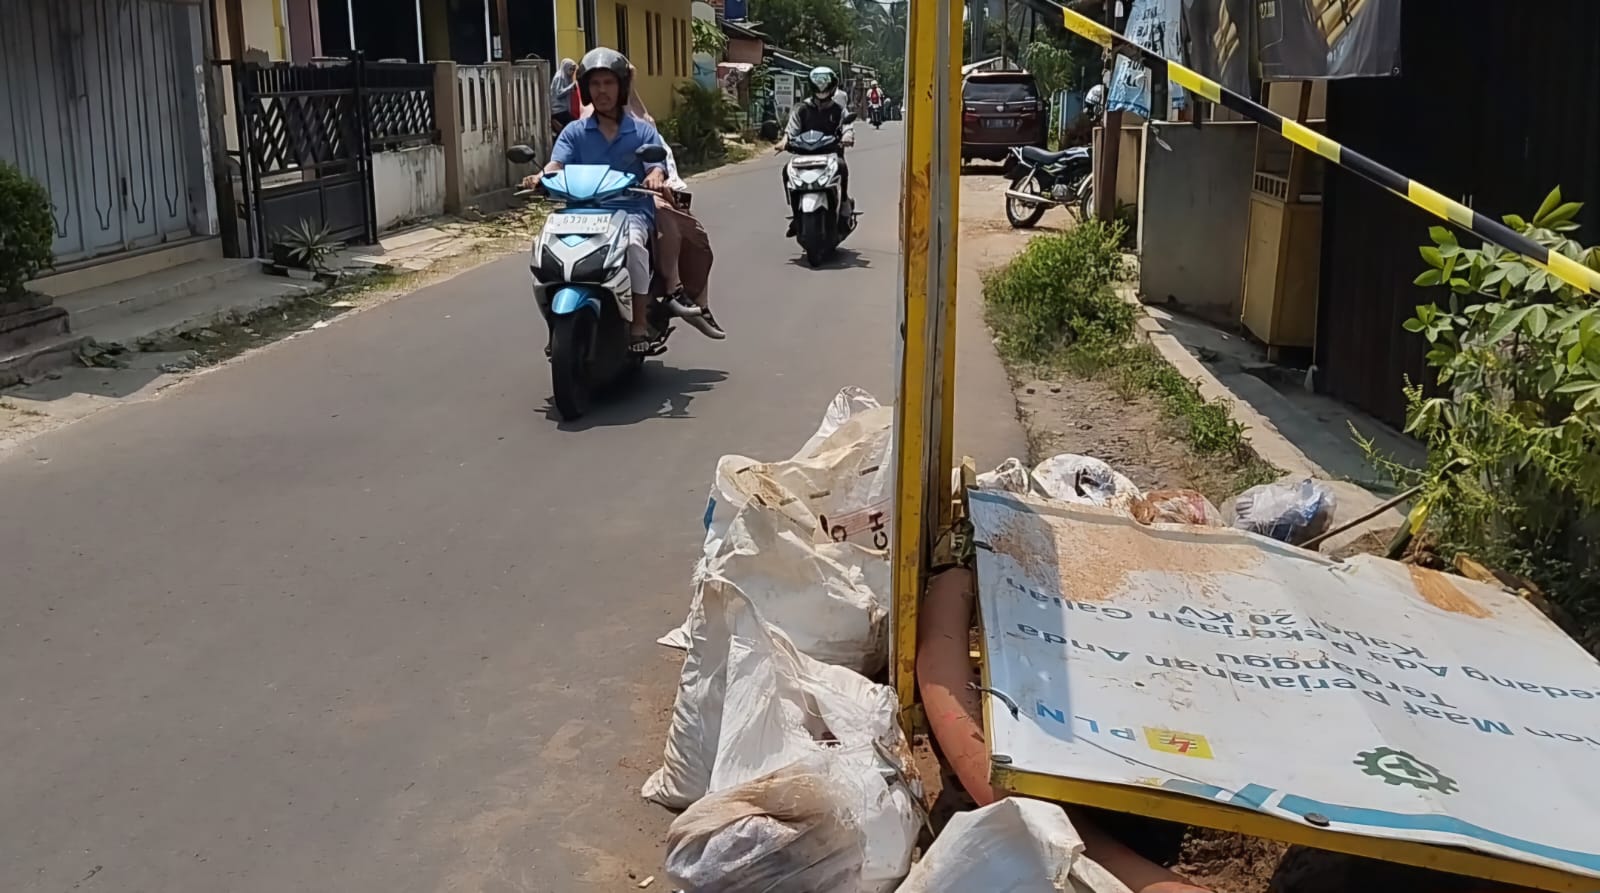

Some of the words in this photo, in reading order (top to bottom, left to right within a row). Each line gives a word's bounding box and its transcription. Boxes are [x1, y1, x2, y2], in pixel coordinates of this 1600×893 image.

[1007, 577, 1133, 620] Galian
[1148, 609, 1357, 656] Pekerjaan
[1248, 612, 1297, 627] 20
[1017, 623, 1131, 662] Anda
[1146, 654, 1391, 706] Perjalanan
[1215, 652, 1457, 709] Terganggu
[1368, 650, 1448, 678] Ada
[1036, 701, 1136, 742] PLN
[1403, 700, 1514, 736] Maaf
